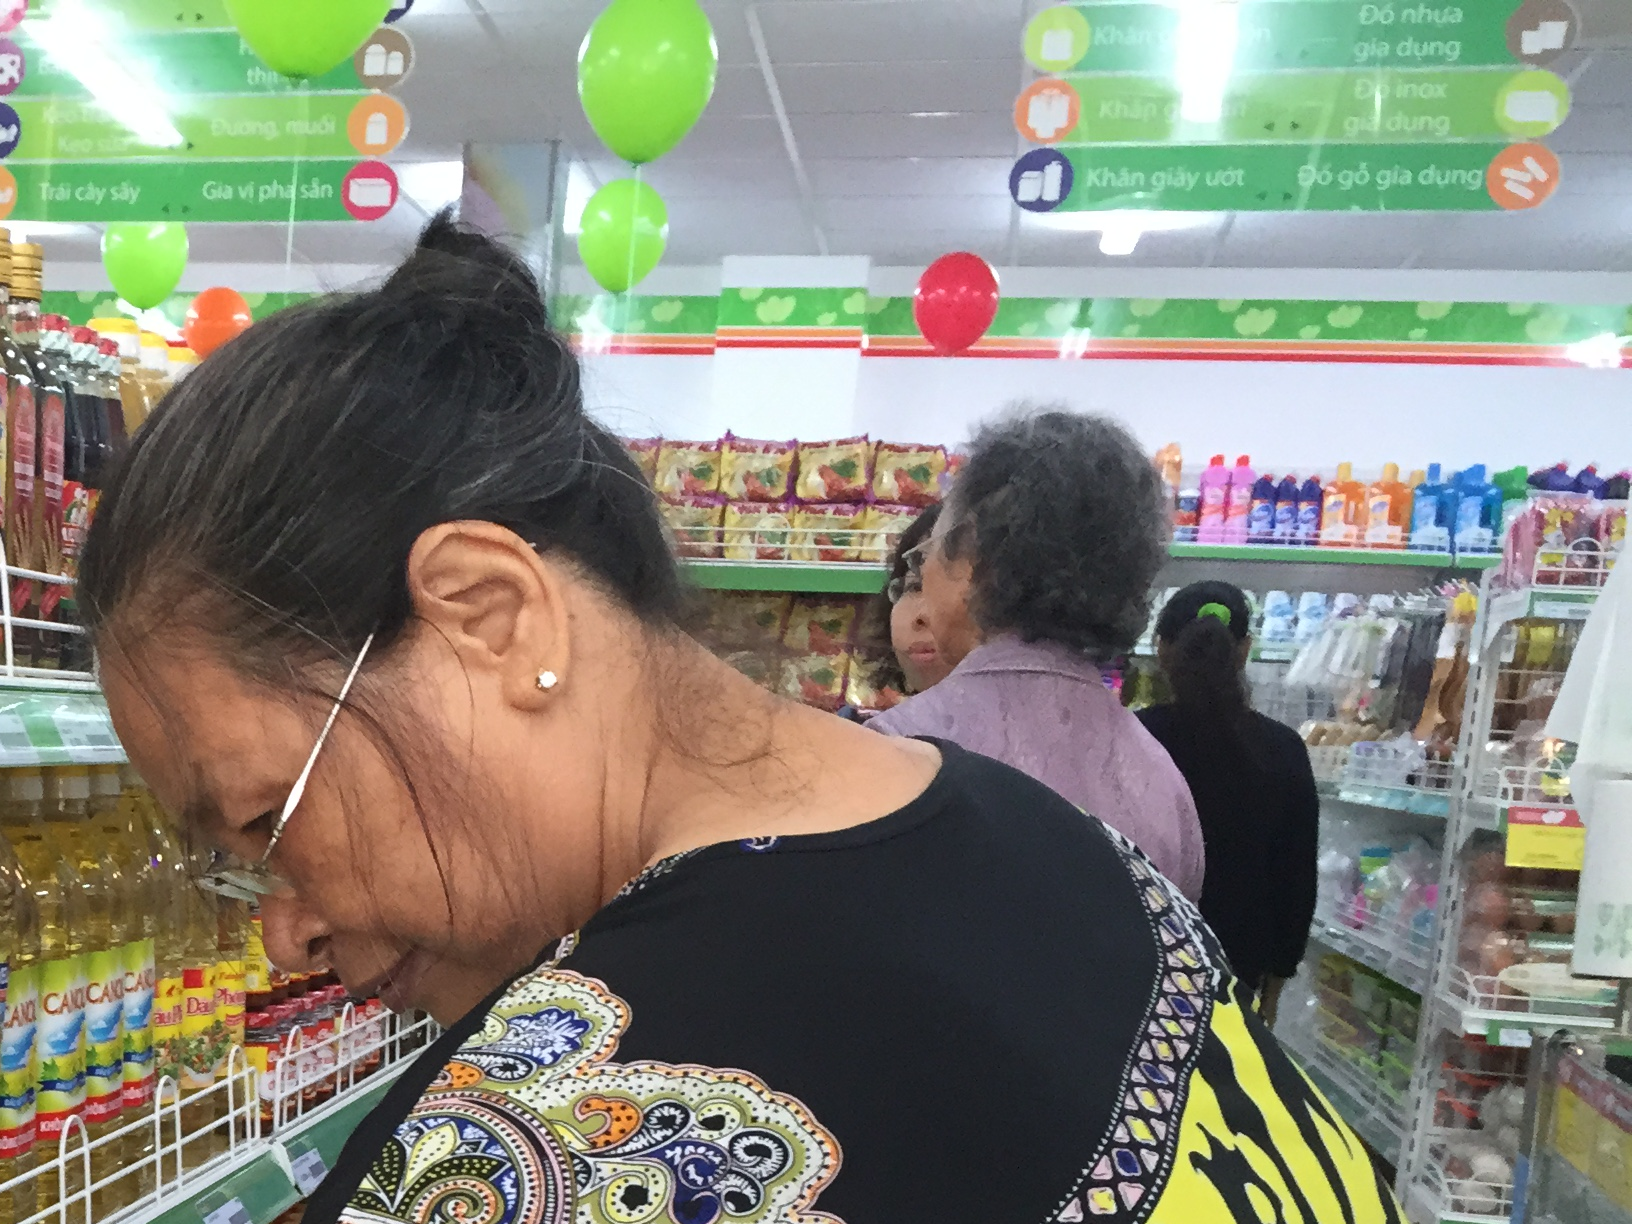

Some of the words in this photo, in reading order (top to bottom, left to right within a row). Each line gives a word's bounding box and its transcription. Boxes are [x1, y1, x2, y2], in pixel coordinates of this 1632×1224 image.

[1354, 37, 1390, 61] gia
[1394, 79, 1448, 98] inox
[1375, 167, 1411, 190] gia
[202, 181, 233, 200] Gia
